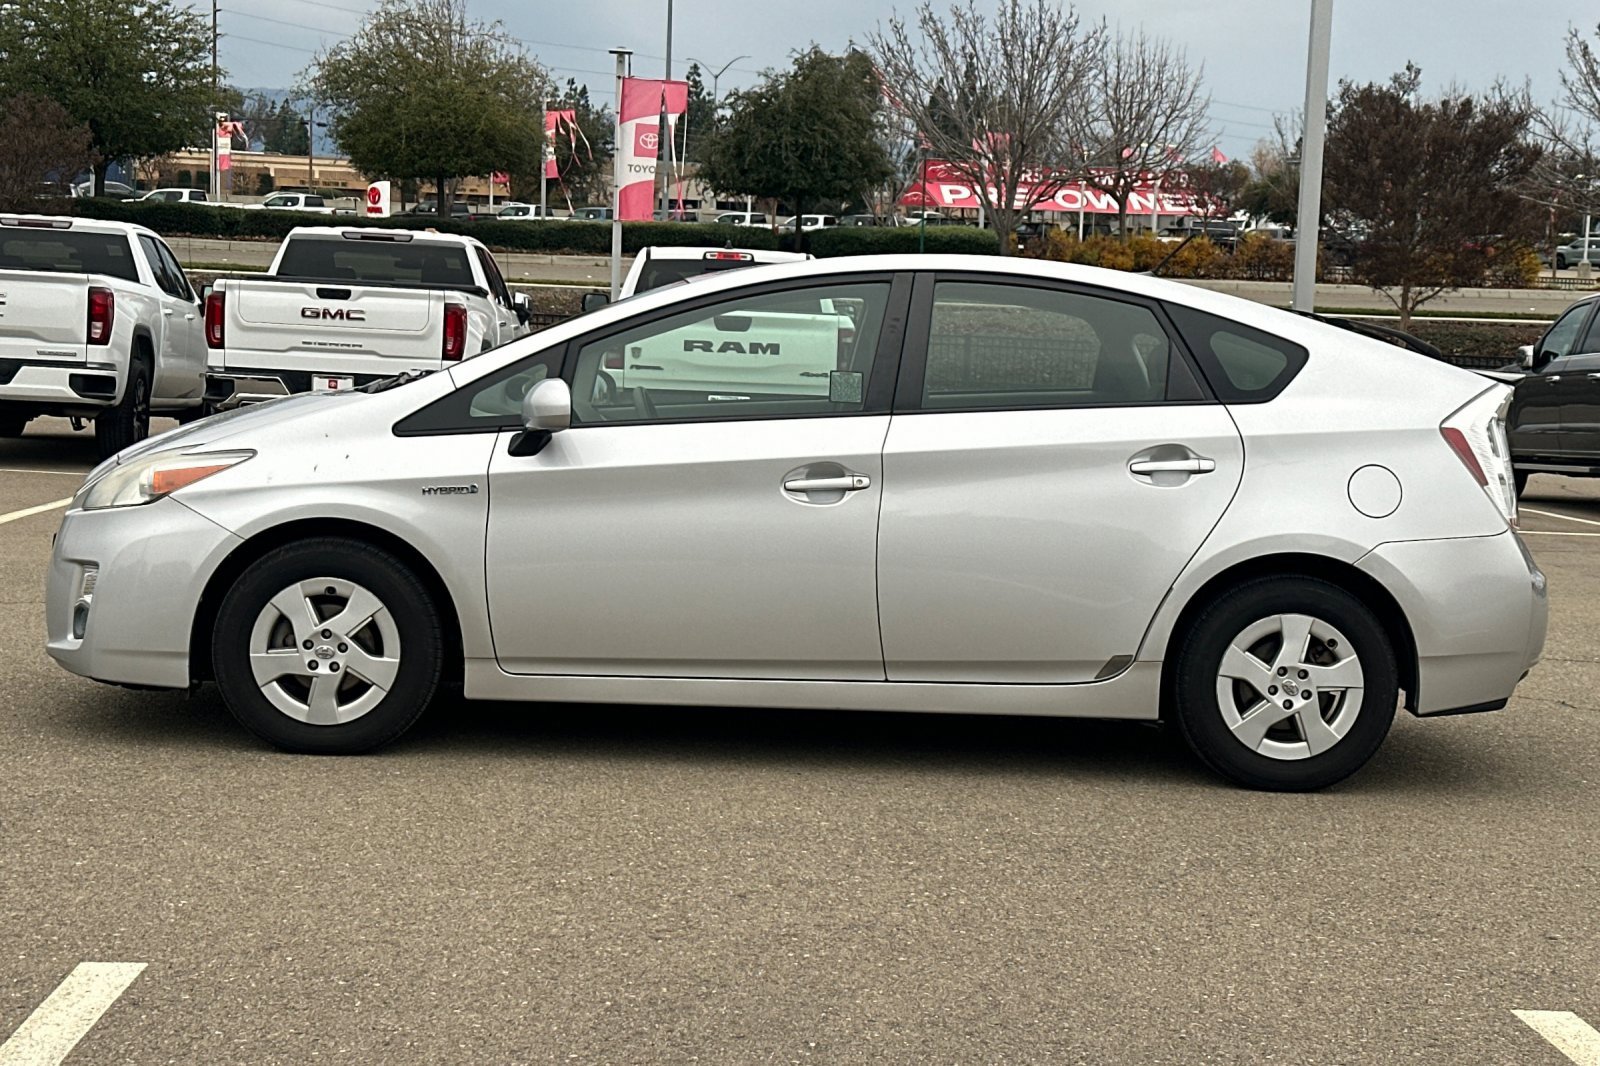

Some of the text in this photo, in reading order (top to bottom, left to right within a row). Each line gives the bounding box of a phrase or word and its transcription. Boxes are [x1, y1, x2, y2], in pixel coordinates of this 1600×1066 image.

[301, 307, 366, 321] GMC
[683, 339, 781, 356] RAM
[421, 486, 470, 496] HYBRID
